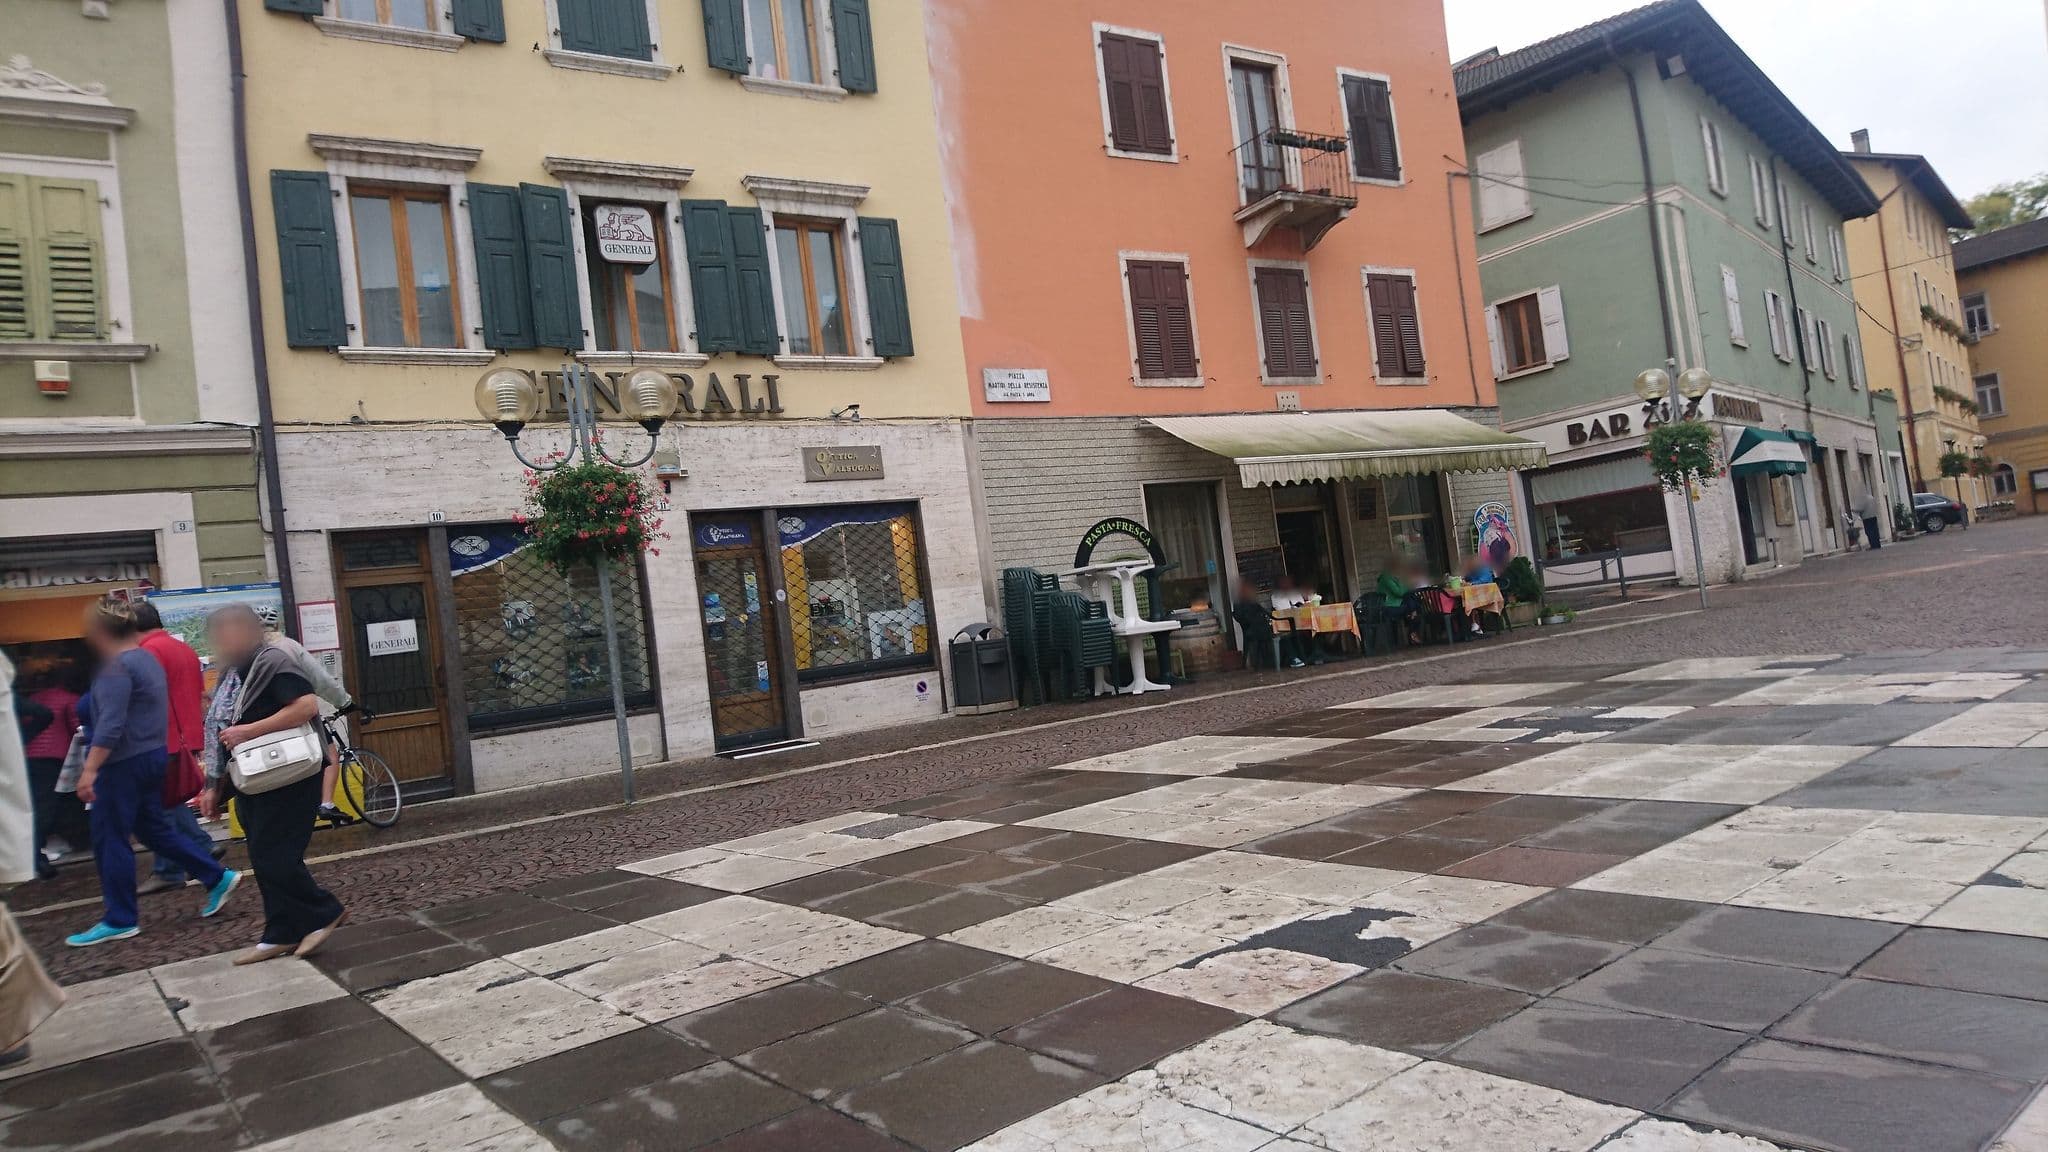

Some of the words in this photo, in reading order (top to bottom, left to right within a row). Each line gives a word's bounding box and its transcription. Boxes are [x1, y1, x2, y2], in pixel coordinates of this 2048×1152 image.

[604, 244, 652, 255] GENERALI
[1008, 372, 1025, 380] PIAZZA
[513, 368, 785, 414] ENRALI
[1567, 412, 1631, 446] BAR
[432, 513, 441, 521] 10
[179, 522, 186, 531] 9
[1085, 521, 1113, 547] PASTA
[1116, 521, 1152, 546] FRESCA
[370, 637, 416, 650] GENERALI
